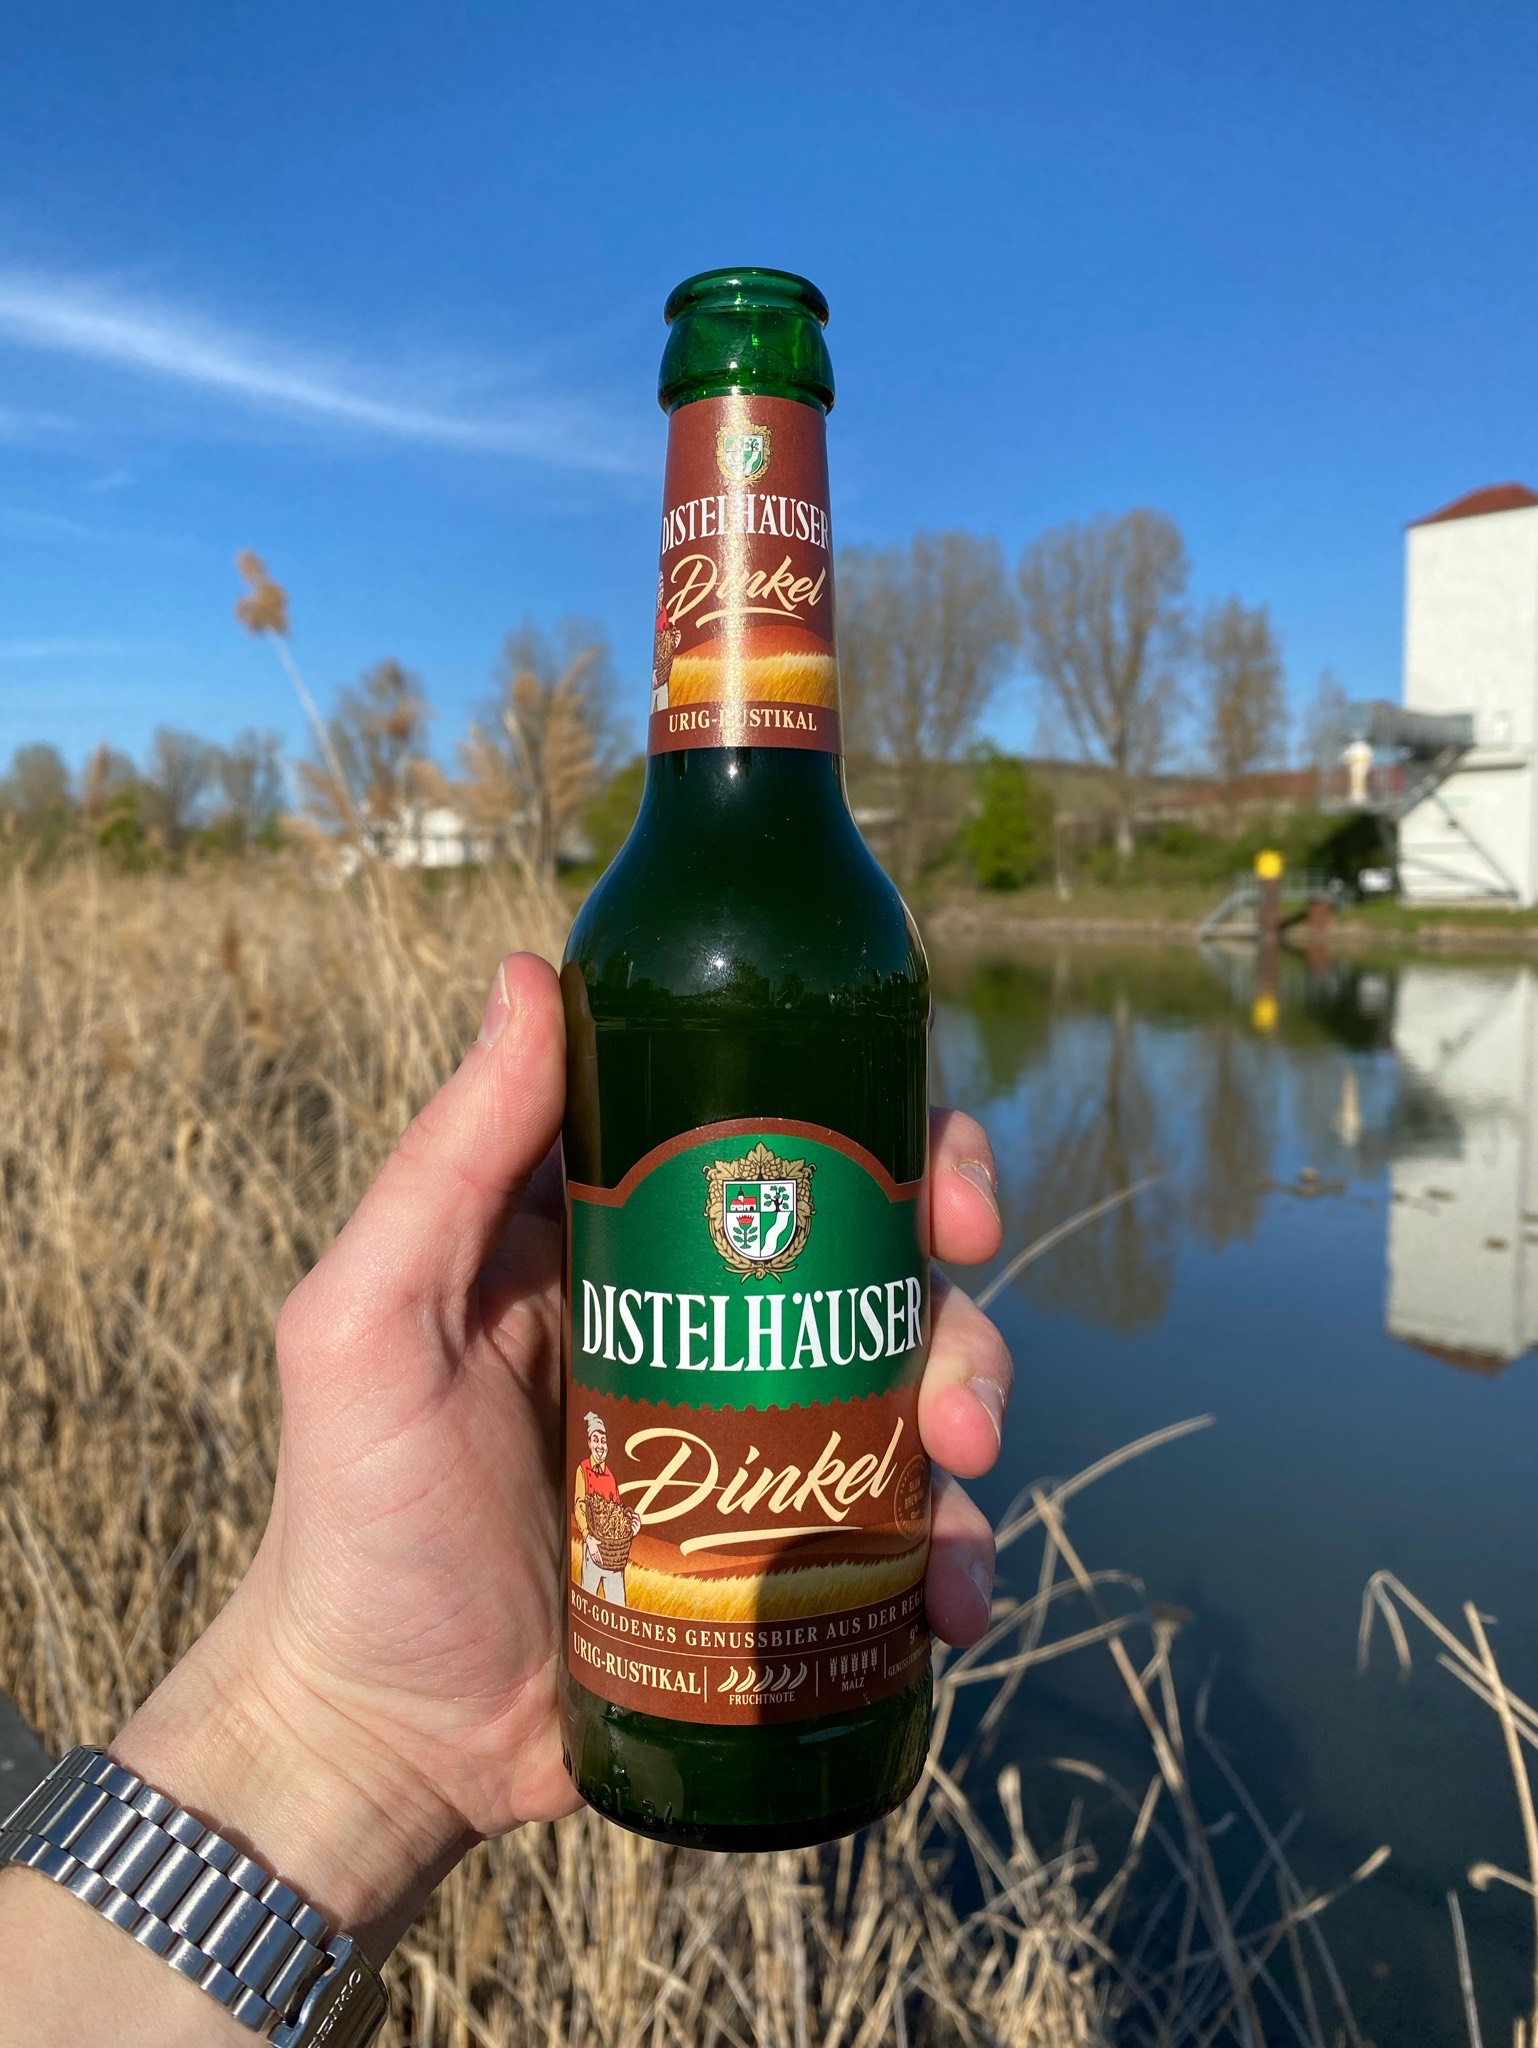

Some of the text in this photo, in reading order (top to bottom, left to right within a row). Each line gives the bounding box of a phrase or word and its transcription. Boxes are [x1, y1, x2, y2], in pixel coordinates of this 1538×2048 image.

[661, 493, 830, 556] DISTELHÄUSER
[665, 553, 827, 626] Dinkel
[581, 1276, 924, 1372] DISTELHÄUSER
[617, 1416, 905, 1525] Dinkel
[571, 1588, 677, 1644] ROT-GOLDENES
[685, 1626, 818, 1649] GENUSSBIER
[826, 1616, 861, 1640] AUS
[867, 1605, 897, 1630] DER
[573, 1631, 701, 1695] URIG-RUSTIKAL
[841, 1676, 865, 1693] MALZ
[728, 1691, 796, 1706] FRUCHTNOTE
